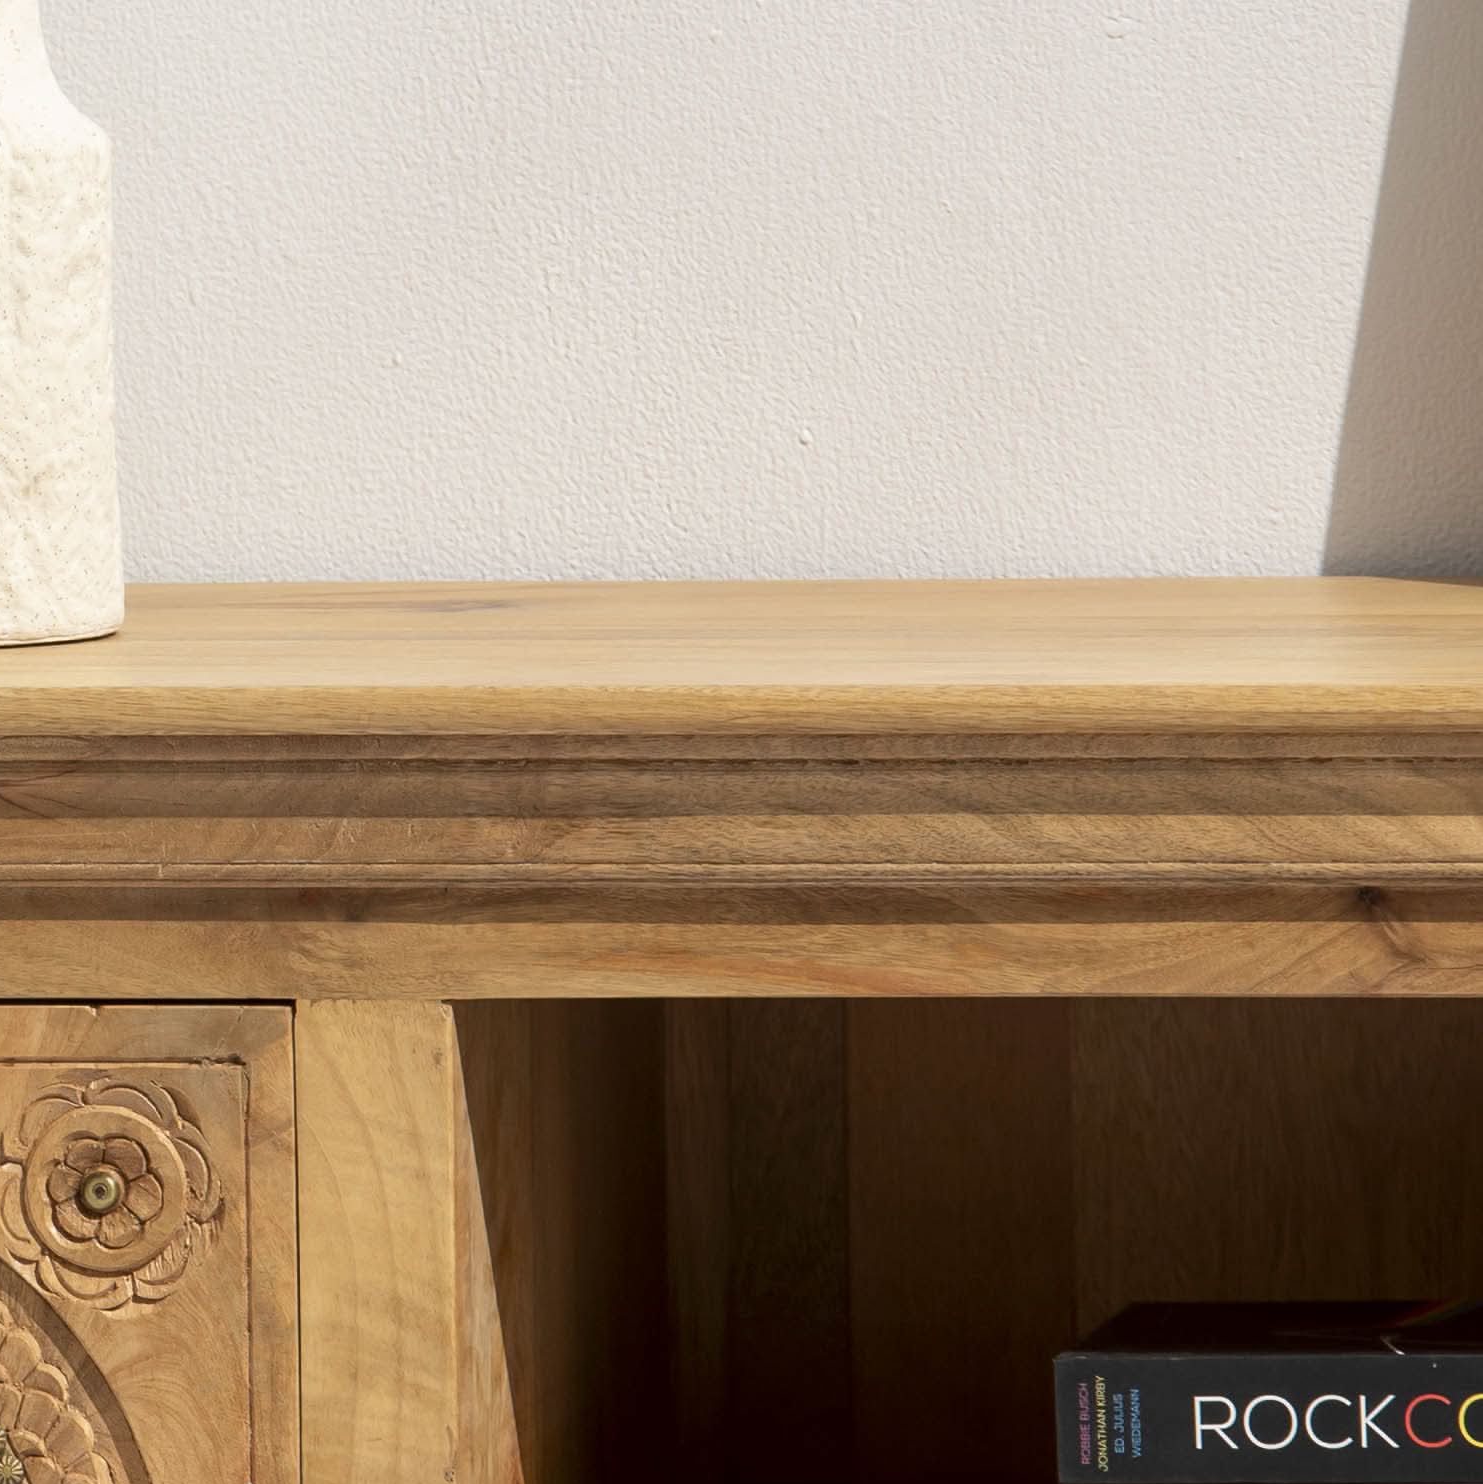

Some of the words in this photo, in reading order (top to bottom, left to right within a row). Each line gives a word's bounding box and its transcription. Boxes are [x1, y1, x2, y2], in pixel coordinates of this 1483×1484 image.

[1078, 1382, 1090, 1421] BUSCH
[1095, 1375, 1106, 1407] KIRBY
[1113, 1393, 1125, 1433] JULIUS
[1129, 1388, 1142, 1458] WIEDEMANN
[1079, 1423, 1091, 1465] ROBBIE
[1097, 1409, 1108, 1472] JONATHAN
